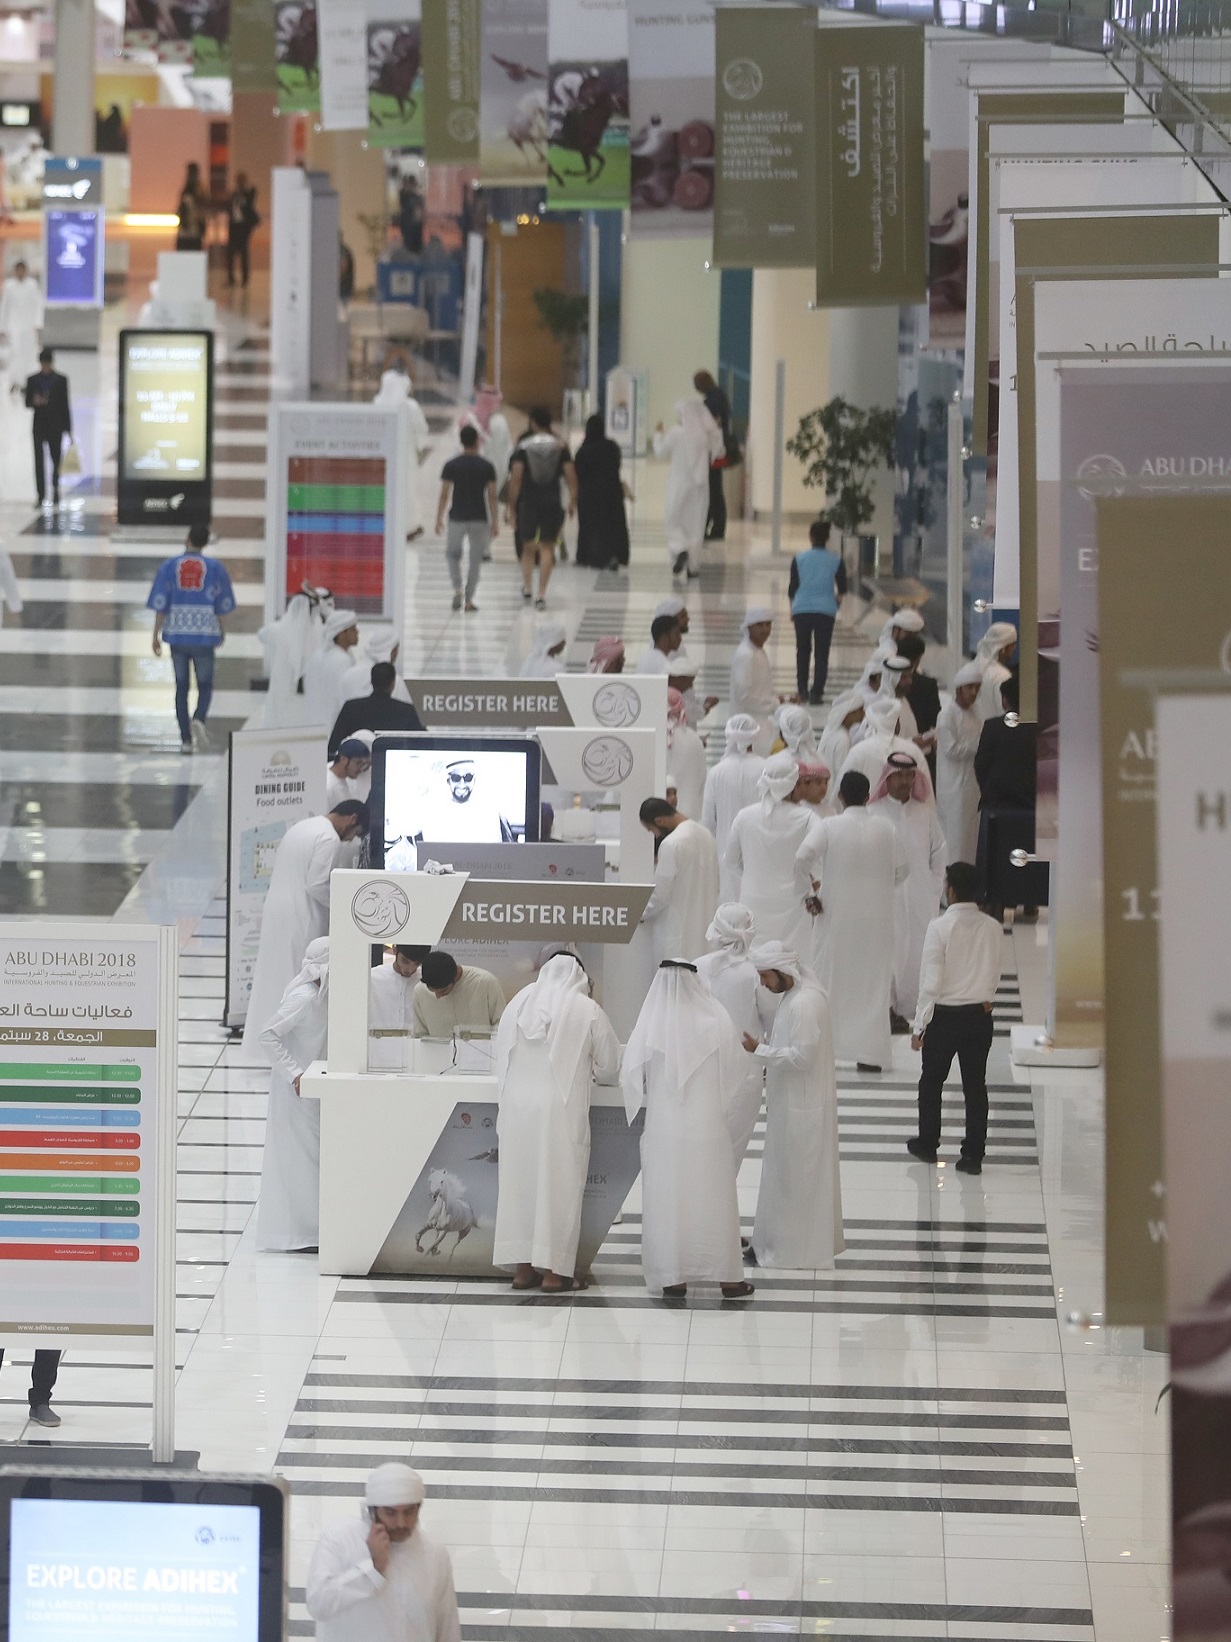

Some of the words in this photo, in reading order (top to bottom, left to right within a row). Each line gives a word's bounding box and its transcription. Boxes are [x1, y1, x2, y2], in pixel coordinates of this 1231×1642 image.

[838, 66, 860, 177] اكتشف
[1141, 457, 1184, 476] ABU
[423, 694, 508, 712] REGISTER
[513, 695, 559, 712] HERE
[255, 783, 281, 795] DINING
[283, 781, 305, 793] GUIDE
[256, 798, 275, 807] Food
[276, 796, 303, 807] outlets
[462, 902, 566, 925] REGISTER
[572, 906, 629, 926] HERE
[5, 952, 38, 966] ABU
[42, 952, 94, 967] DHABI
[97, 953, 136, 967] 2018
[4, 969, 48, 978] والفروسية
[78, 970, 106, 979] الدولي
[107, 971, 136, 979] المعرض
[24, 1003, 69, 1018] ساحة
[72, 1005, 133, 1020] فعاليات
[34, 1031, 49, 1041] 28
[27, 1564, 138, 1591] EXPLORE
[143, 1567, 239, 1594] ADIHEX
